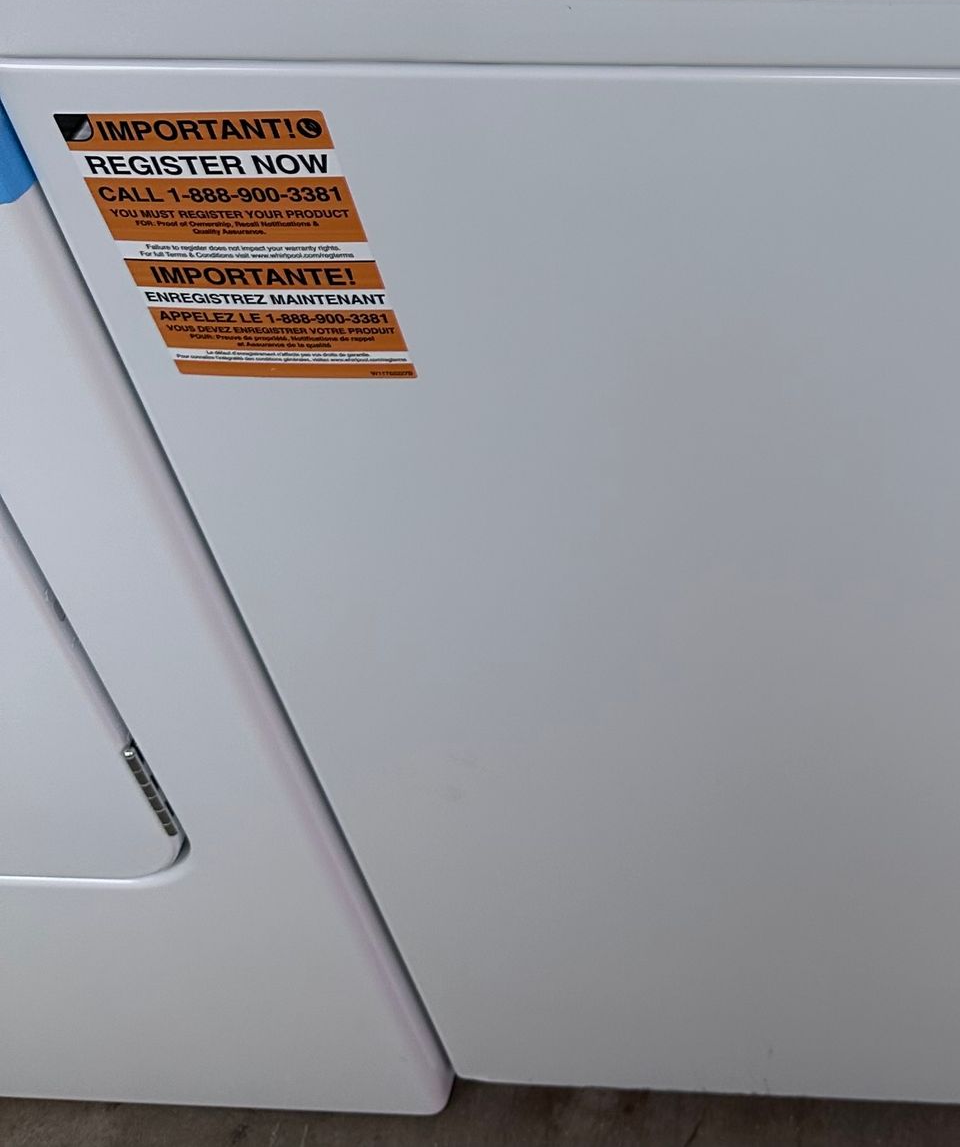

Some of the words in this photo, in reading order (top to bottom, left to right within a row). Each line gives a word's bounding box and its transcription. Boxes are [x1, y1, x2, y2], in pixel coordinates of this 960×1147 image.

[96, 118, 296, 141] IMPORTANT!
[85, 154, 246, 175] REGISTER
[251, 154, 328, 175] NOW
[98, 186, 164, 202] CALL
[167, 186, 342, 202] 1-888-900-3381
[110, 209, 138, 218] YOU
[140, 210, 175, 218] MUST
[178, 210, 243, 219] REGISTER
[247, 210, 284, 218] YOUR
[286, 209, 349, 218] PRODUCT
[150, 266, 356, 285] IMPORTANTE!
[144, 292, 267, 304] ENREGISTREZ
[270, 294, 385, 304] MAINTENANT
[159, 311, 237, 323] APPELEZ
[239, 313, 263, 323] LE
[266, 314, 389, 323] 1-888-900-3381
